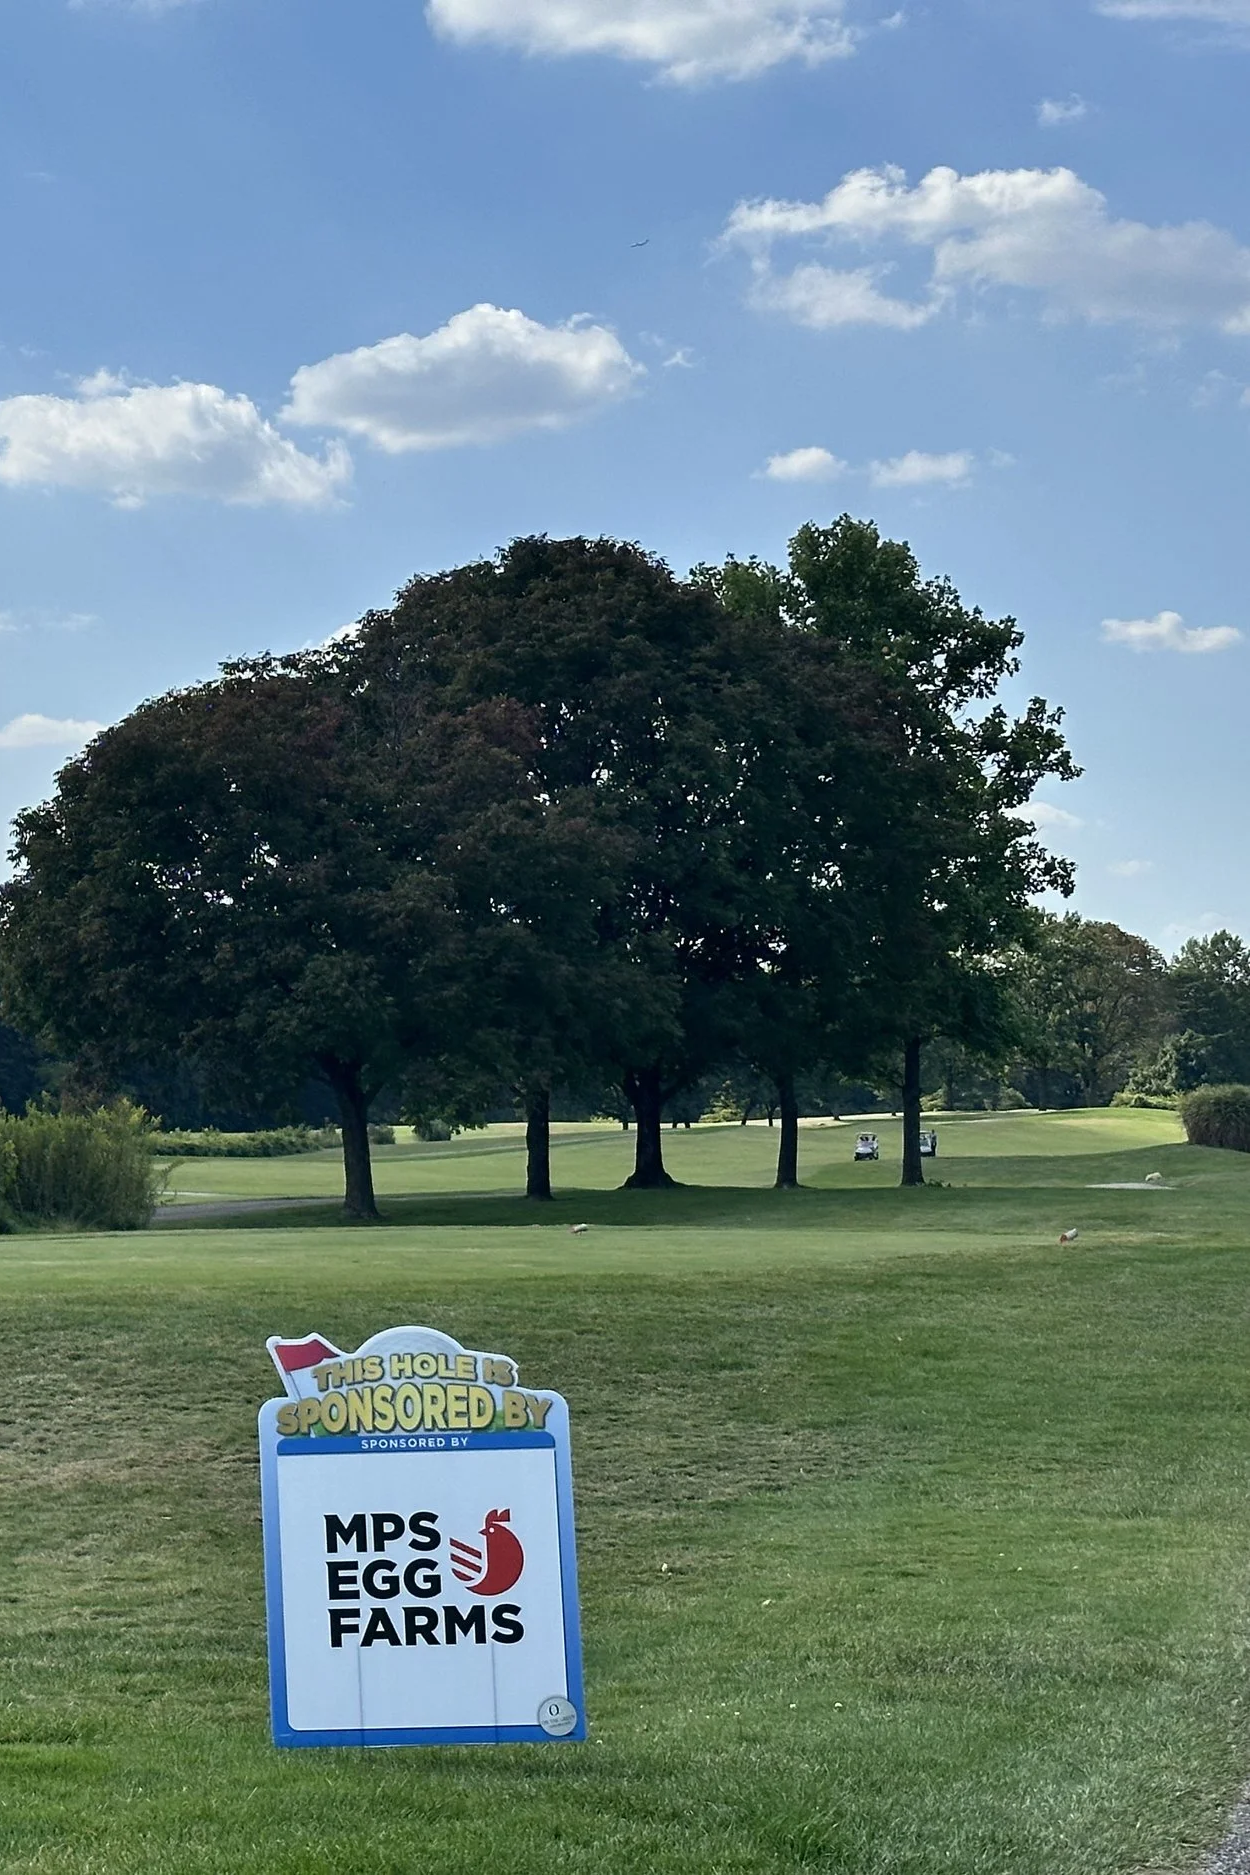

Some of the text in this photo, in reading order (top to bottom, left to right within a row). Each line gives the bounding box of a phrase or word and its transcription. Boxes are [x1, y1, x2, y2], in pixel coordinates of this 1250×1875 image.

[314, 1353, 514, 1391] THIS HOLE IS
[277, 1384, 552, 1435] SPONSORED BY
[361, 1437, 468, 1449] SPONSORED BY
[324, 1511, 442, 1553] MPS
[326, 1558, 442, 1600] EGG
[328, 1604, 524, 1648] FARMS
